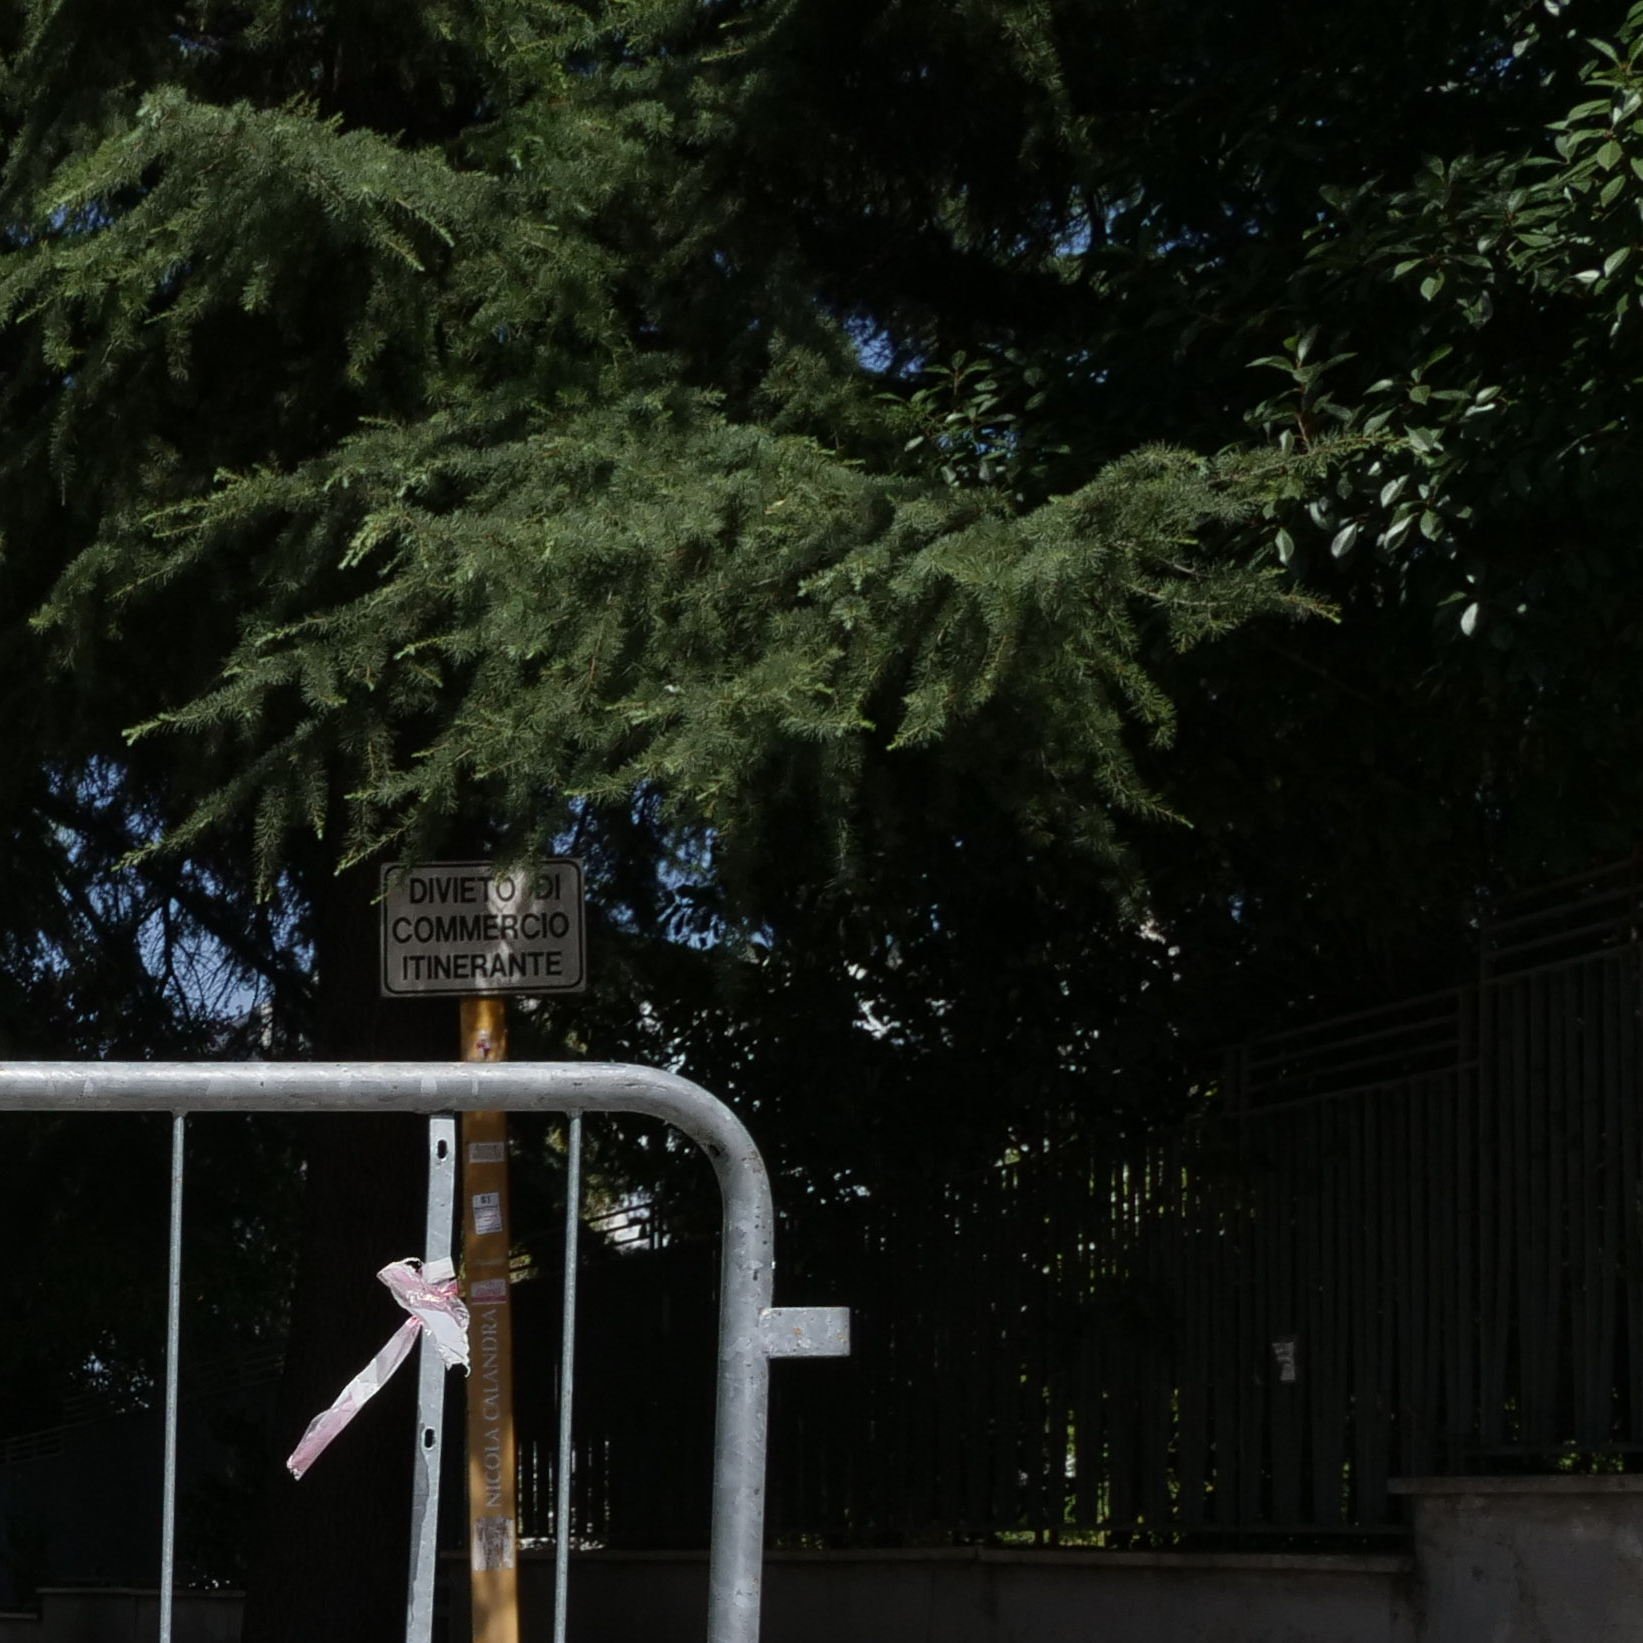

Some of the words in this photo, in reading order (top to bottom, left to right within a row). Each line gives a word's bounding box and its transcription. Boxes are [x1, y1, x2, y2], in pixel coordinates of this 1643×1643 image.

[409, 876, 515, 904] DIVIETO
[539, 873, 561, 900] DI
[392, 911, 570, 944] COMMERCIO
[402, 951, 564, 981] ITINERANTE
[480, 1308, 500, 1422] CALANDRA
[483, 1428, 502, 1508] NICOLA
